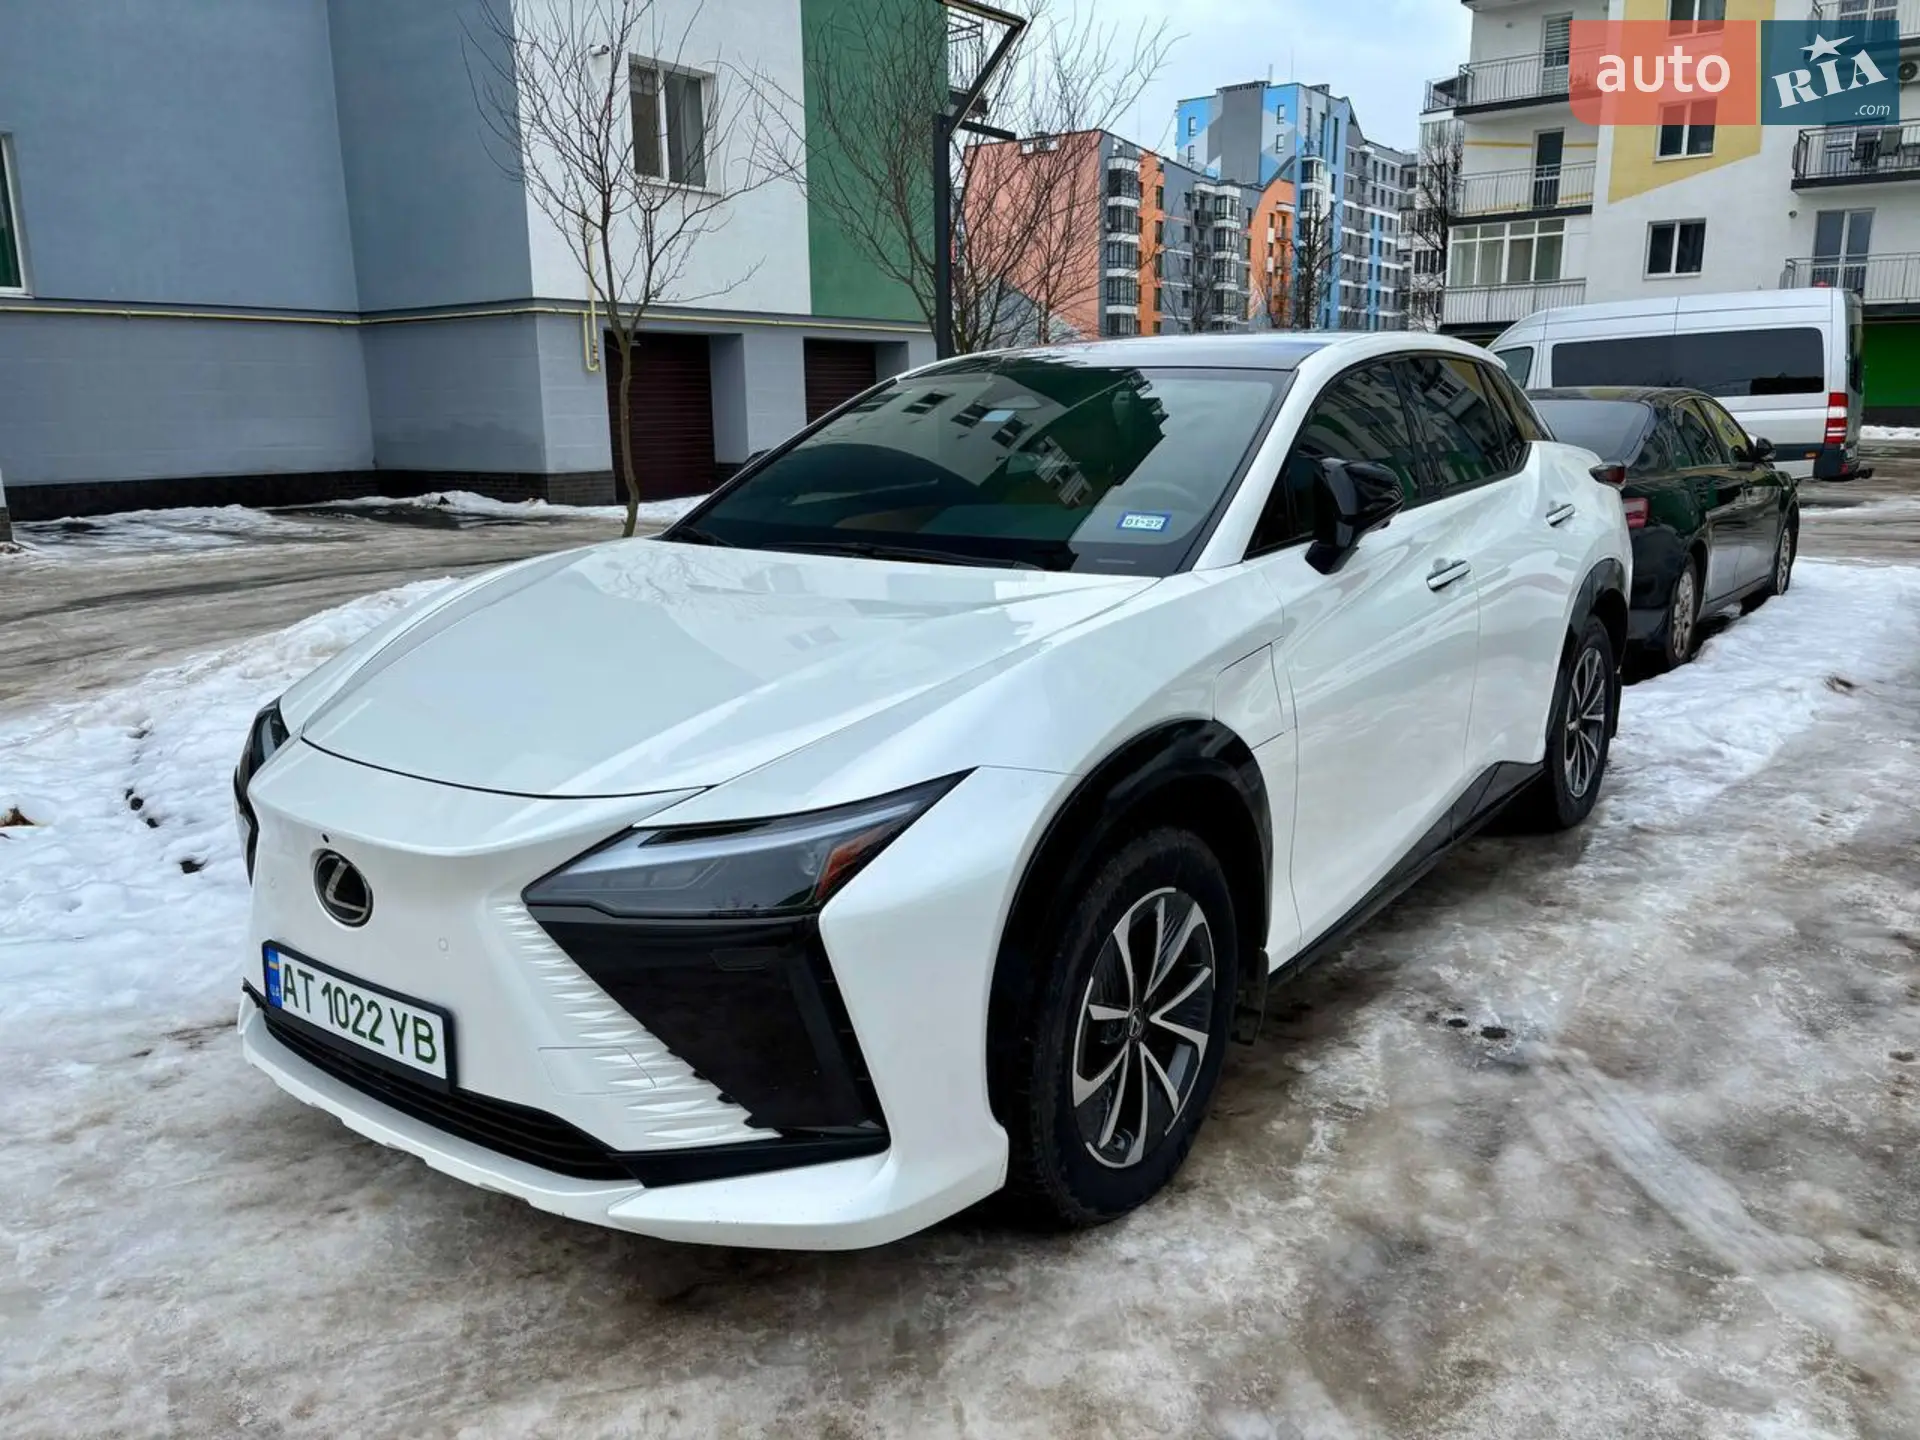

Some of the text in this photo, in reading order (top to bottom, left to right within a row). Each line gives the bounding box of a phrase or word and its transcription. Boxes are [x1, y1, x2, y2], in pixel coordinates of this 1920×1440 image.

[283, 963, 436, 1064] AT 1022 YB
